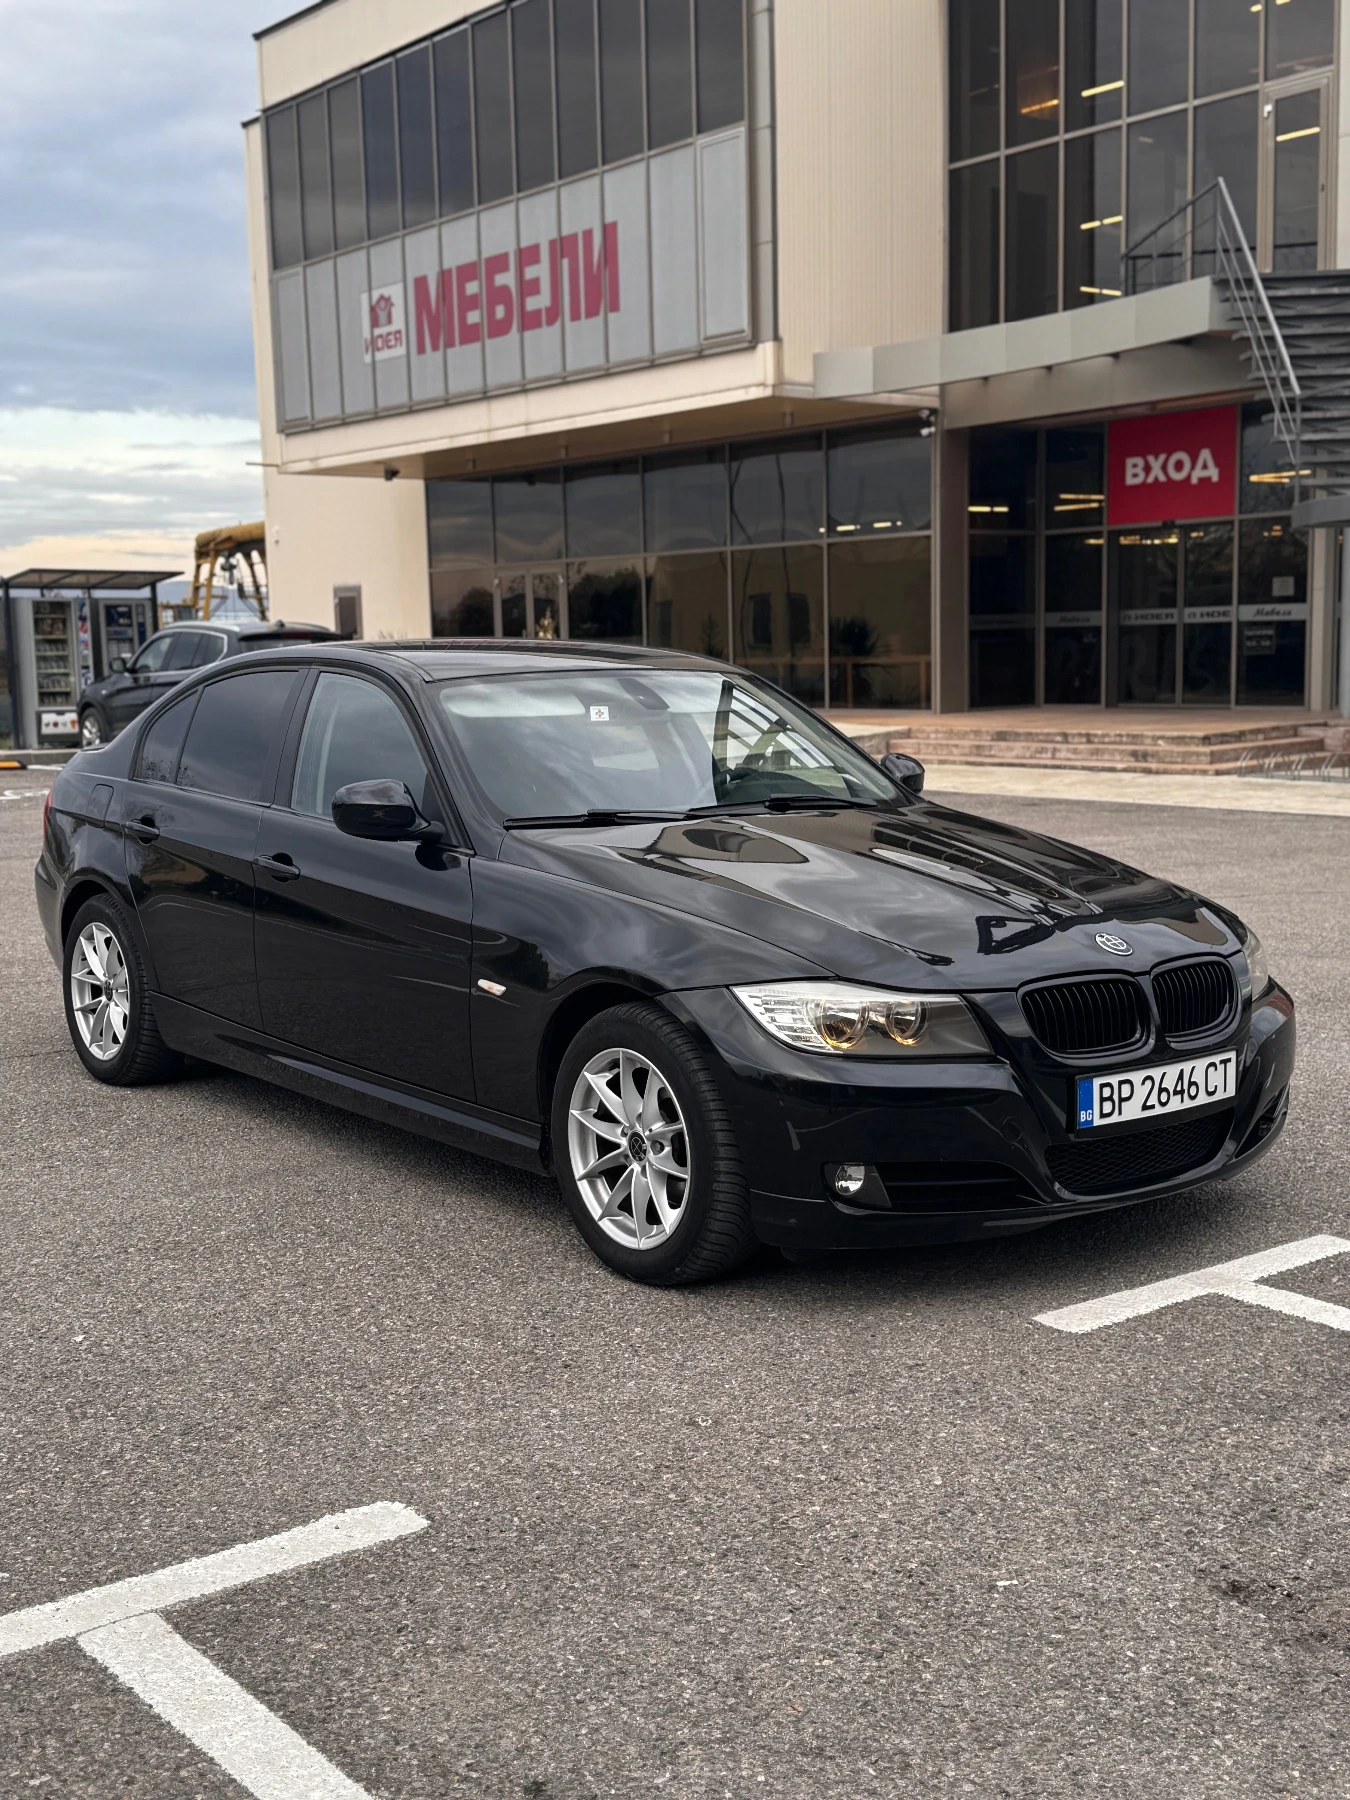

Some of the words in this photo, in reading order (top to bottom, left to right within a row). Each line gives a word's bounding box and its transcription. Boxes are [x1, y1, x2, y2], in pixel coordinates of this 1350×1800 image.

[414, 221, 620, 355] МЕБЕЛИ
[1125, 448, 1219, 486] ВХОД
[1098, 1077, 1135, 1120] BP
[1140, 1065, 1200, 1112] 2646
[1204, 1057, 1232, 1097] CT
[1080, 1109, 1093, 1122] BG
